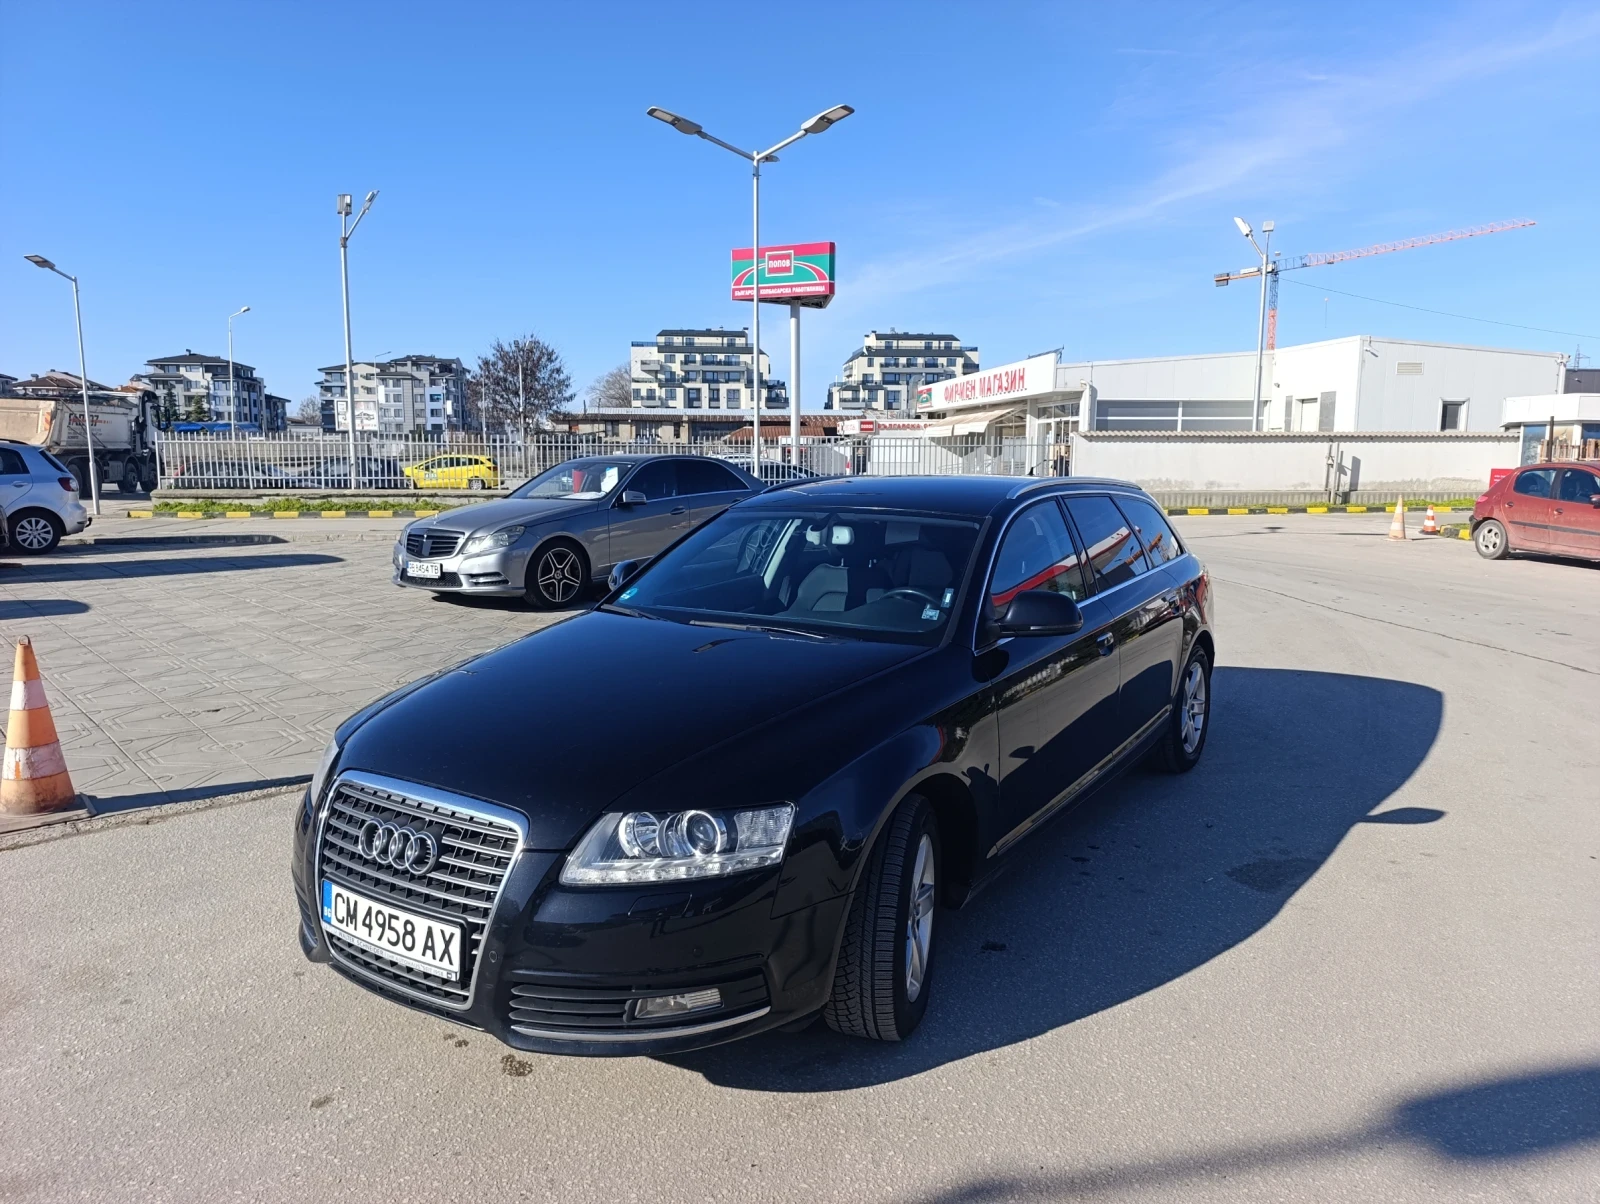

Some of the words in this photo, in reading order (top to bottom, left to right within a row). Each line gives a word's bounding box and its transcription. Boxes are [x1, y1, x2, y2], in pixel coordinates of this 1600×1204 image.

[979, 367, 1026, 396] МАГАЗИН
[324, 906, 332, 918] BG
[334, 892, 358, 931] CM
[362, 905, 416, 952] 4958
[421, 925, 456, 966] AX
